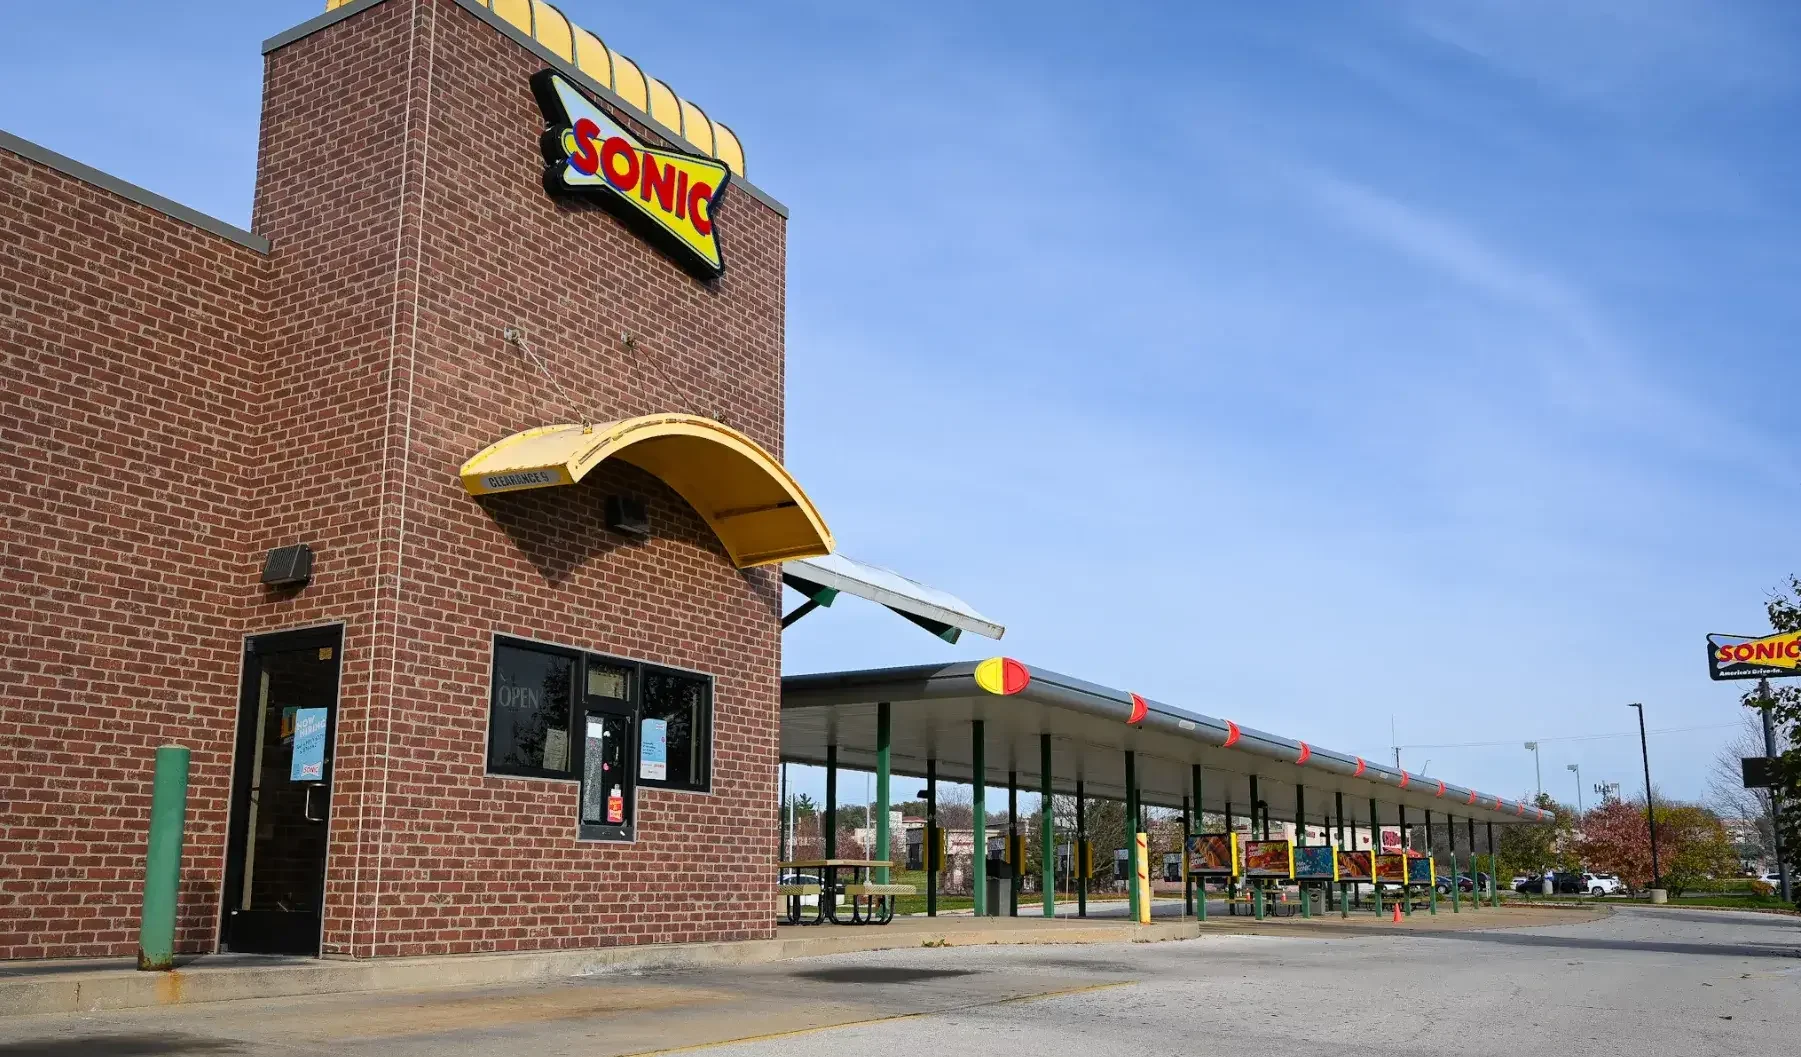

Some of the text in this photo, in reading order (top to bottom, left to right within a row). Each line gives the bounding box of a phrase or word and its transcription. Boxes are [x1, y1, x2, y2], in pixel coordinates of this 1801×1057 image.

[566, 118, 713, 236] SONIC
[488, 473, 541, 488] CLEARANCE
[1719, 641, 1800, 662] SONIC
[499, 685, 539, 709] OPEN
[296, 715, 316, 731] NOW
[299, 719, 327, 737] HIRING
[303, 766, 319, 774] SONIC
